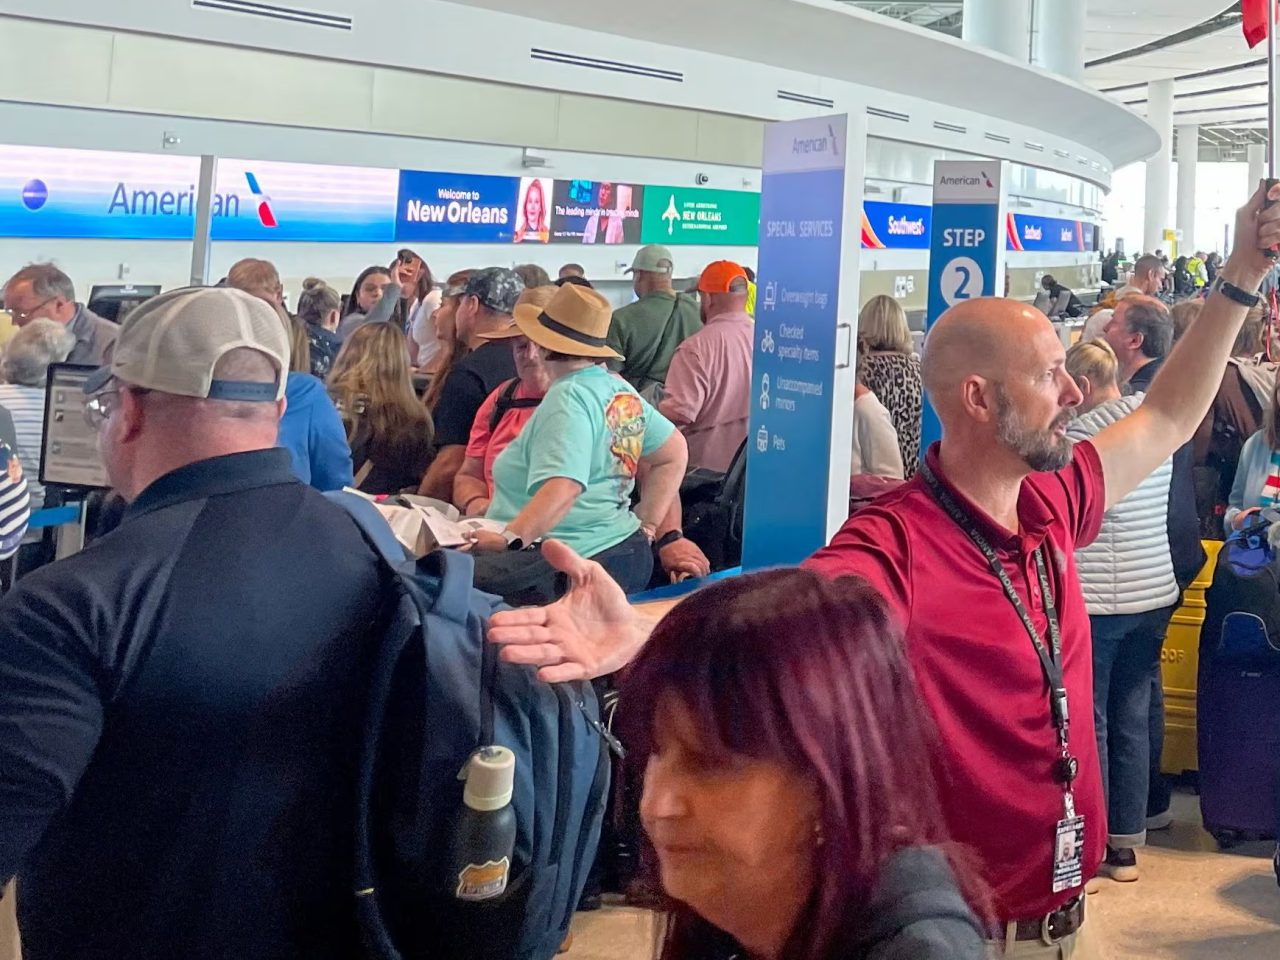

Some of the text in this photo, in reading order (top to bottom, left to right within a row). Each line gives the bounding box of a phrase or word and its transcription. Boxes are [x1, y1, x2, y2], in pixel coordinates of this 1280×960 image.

[940, 176, 981, 186] American
[107, 182, 240, 217] Amerian
[438, 188, 480, 201] Welcome to
[407, 200, 508, 224] New Orleans
[767, 220, 834, 238] SPECIAL SERVICES
[888, 215, 923, 236] Southwest
[943, 228, 985, 247] STEP
[953, 266, 970, 299] 2
[773, 434, 785, 451] Pets
